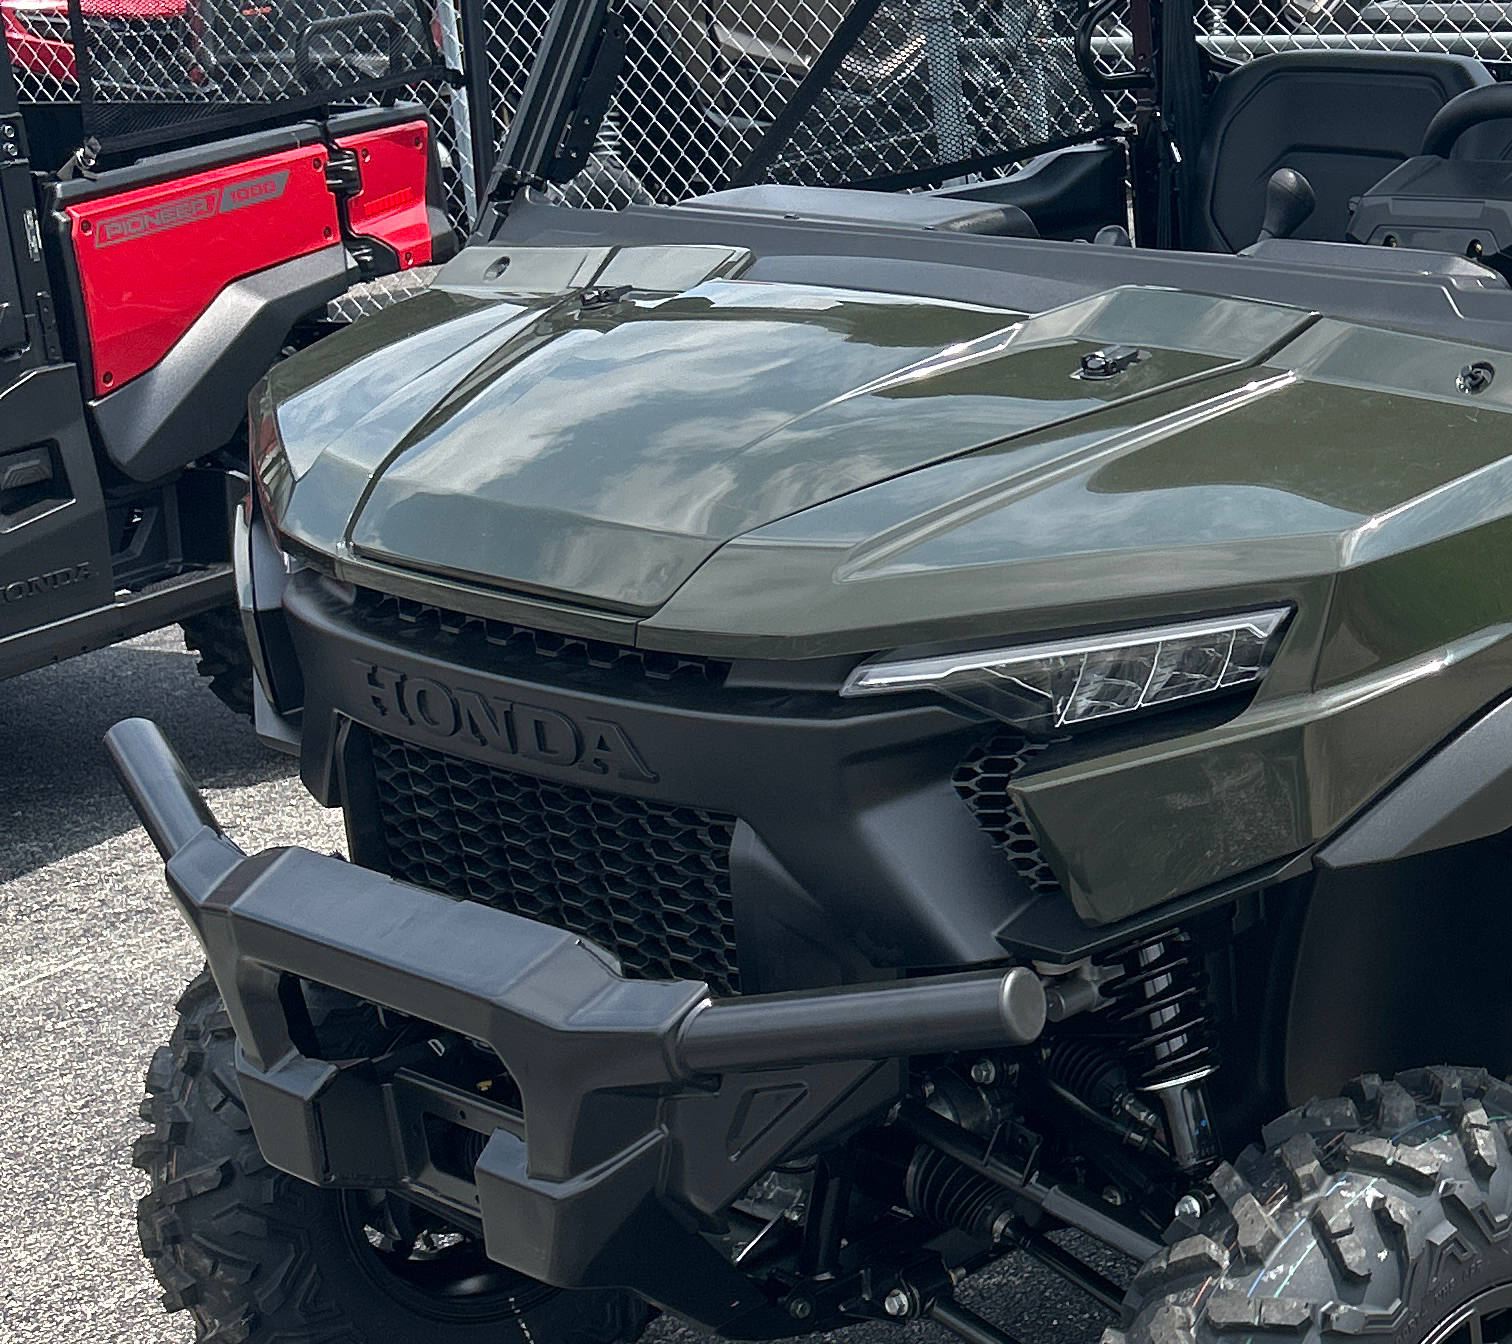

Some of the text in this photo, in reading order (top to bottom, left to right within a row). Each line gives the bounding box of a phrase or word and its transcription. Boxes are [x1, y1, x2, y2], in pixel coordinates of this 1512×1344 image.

[105, 179, 277, 241] PIONEER 1000
[350, 658, 661, 784] HONDA
